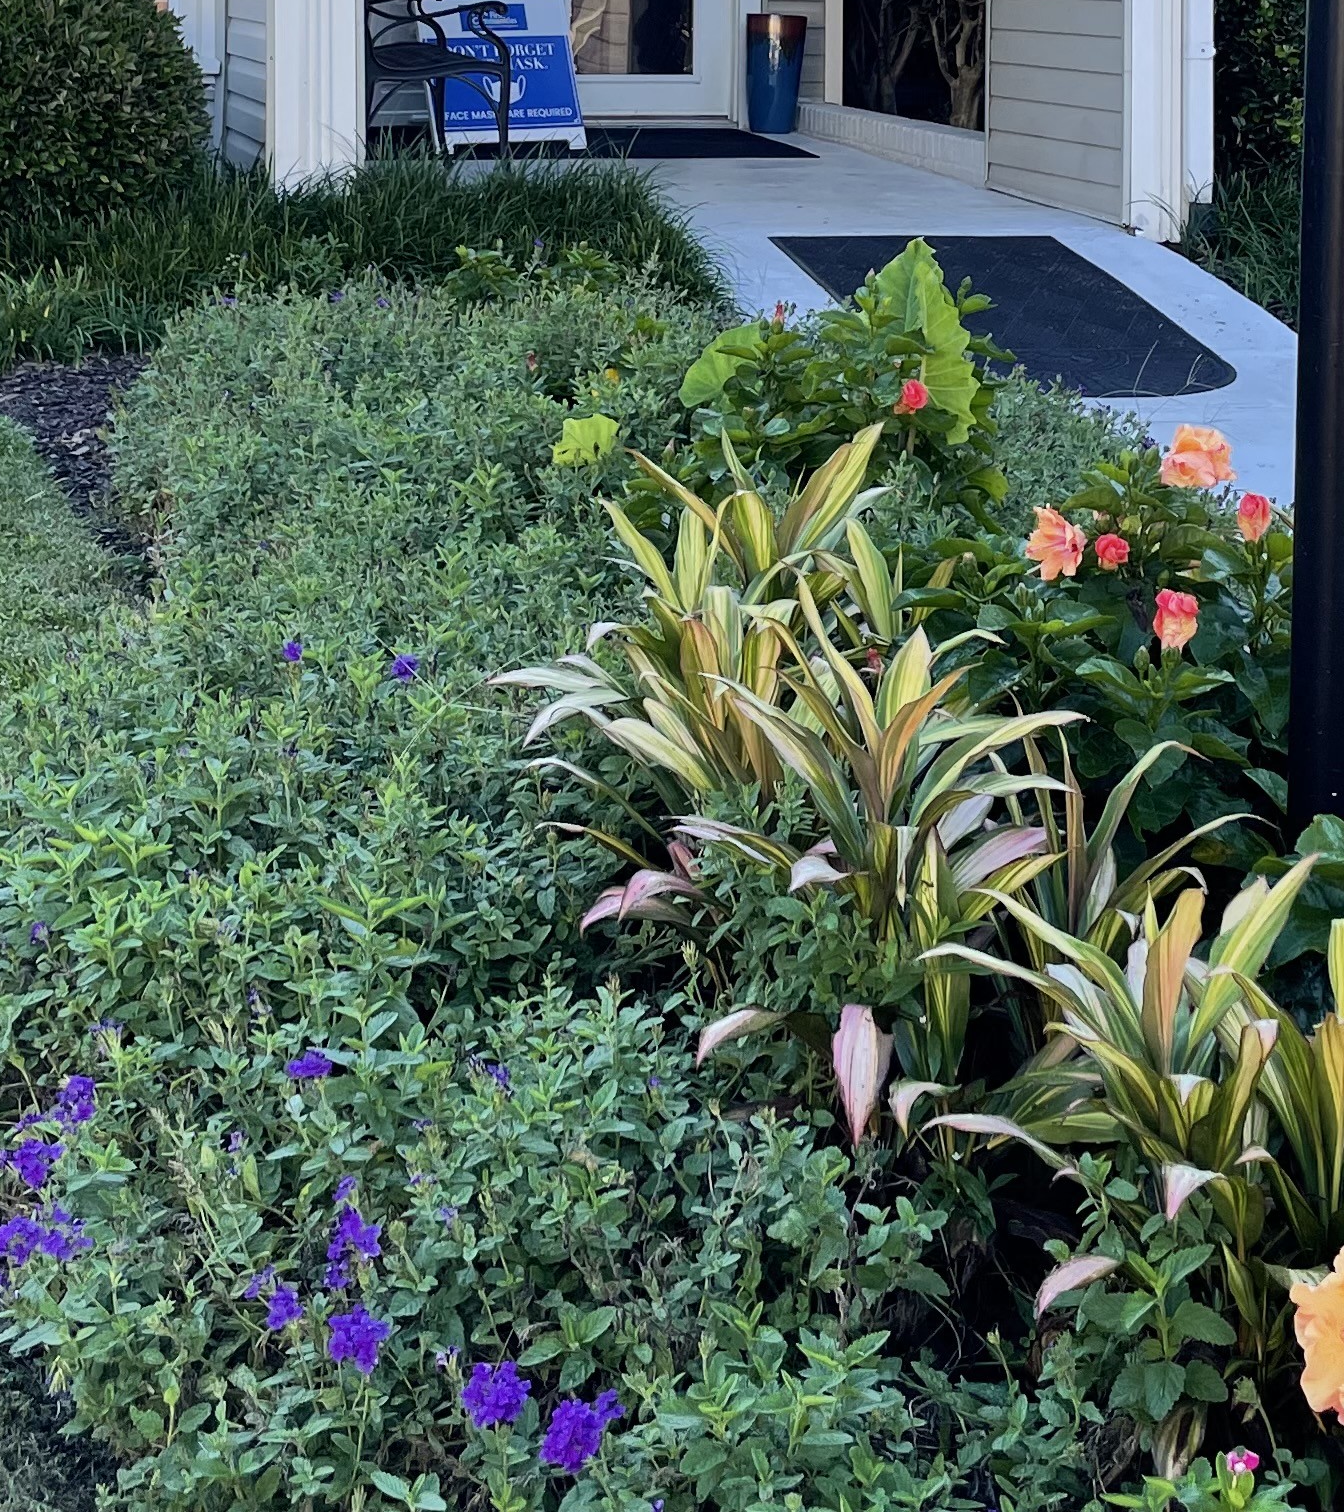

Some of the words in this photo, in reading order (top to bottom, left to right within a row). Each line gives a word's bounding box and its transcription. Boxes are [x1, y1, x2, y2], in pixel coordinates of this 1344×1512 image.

[445, 111, 469, 121] FACE
[472, 110, 497, 120] MAS
[508, 109, 525, 119] ARE
[527, 107, 573, 118] REQUIRED
